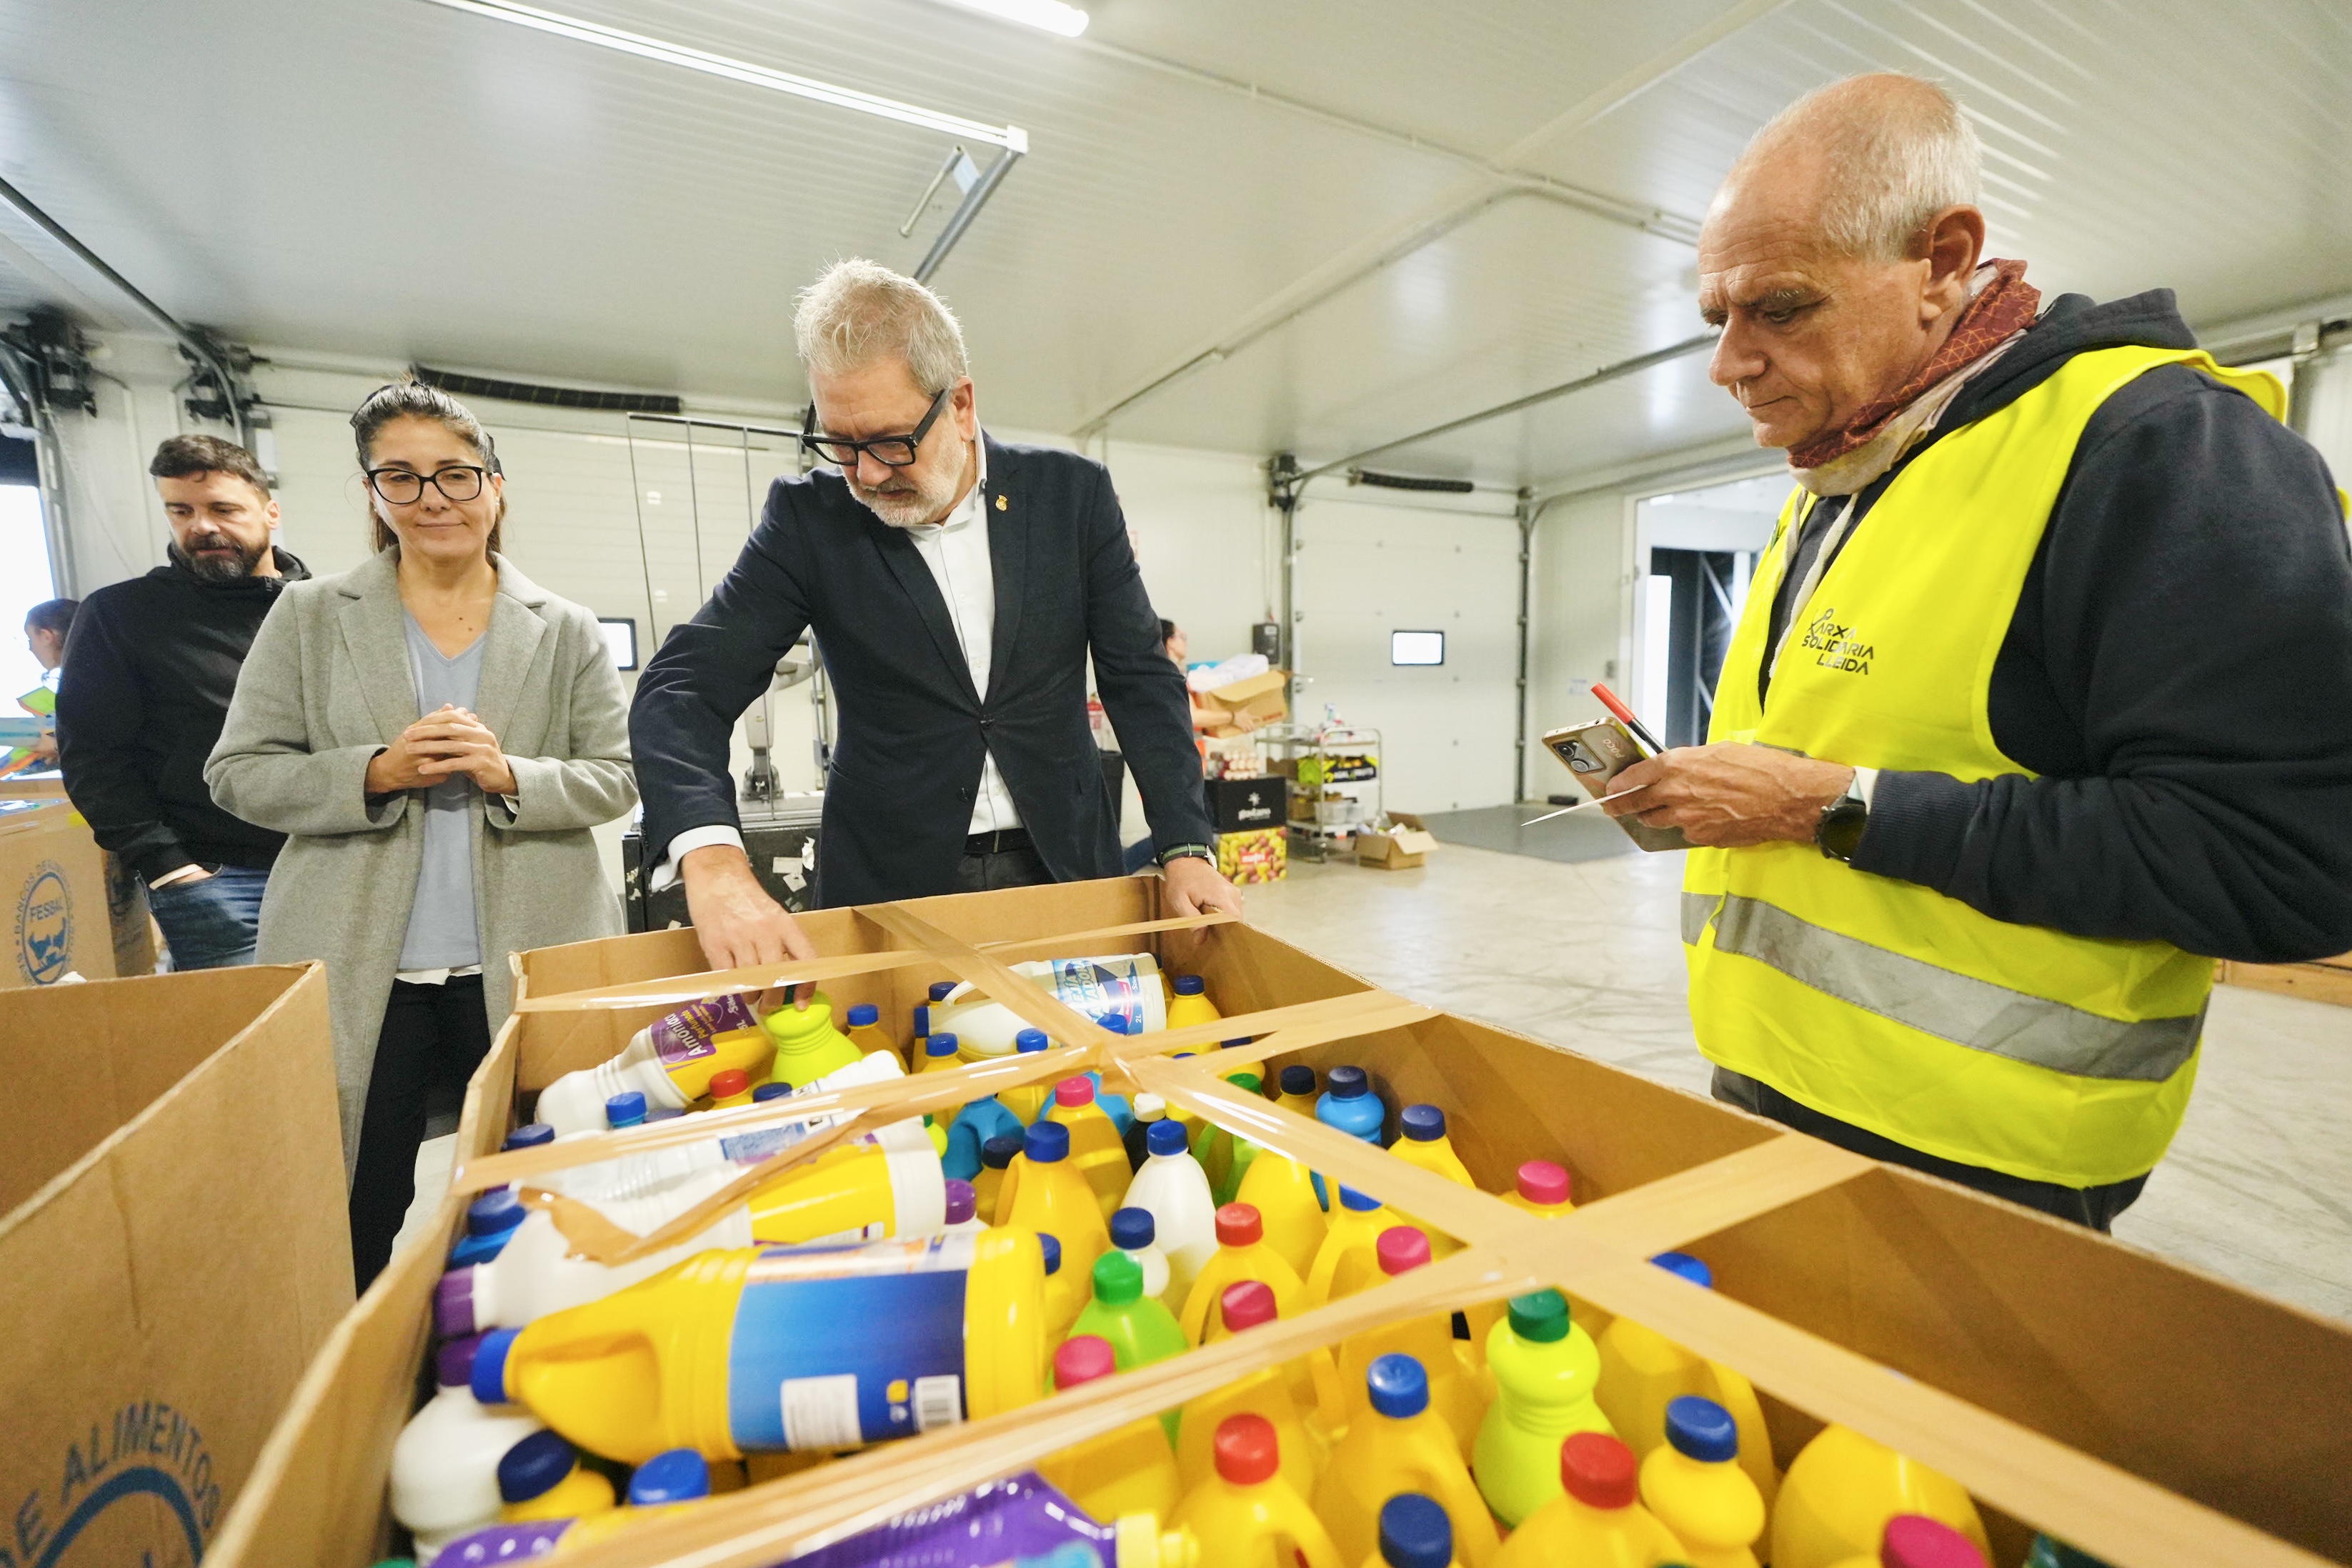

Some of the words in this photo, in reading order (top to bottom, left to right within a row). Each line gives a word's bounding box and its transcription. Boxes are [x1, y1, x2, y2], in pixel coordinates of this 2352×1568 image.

[1802, 634, 1873, 659] SOLIDARIA
[1816, 653, 1868, 675] LLEIDA
[1603, 738, 1625, 759] POCO
[1135, 1014, 1142, 1023] 2L
[61, 1402, 220, 1529] ALIMENTOS
